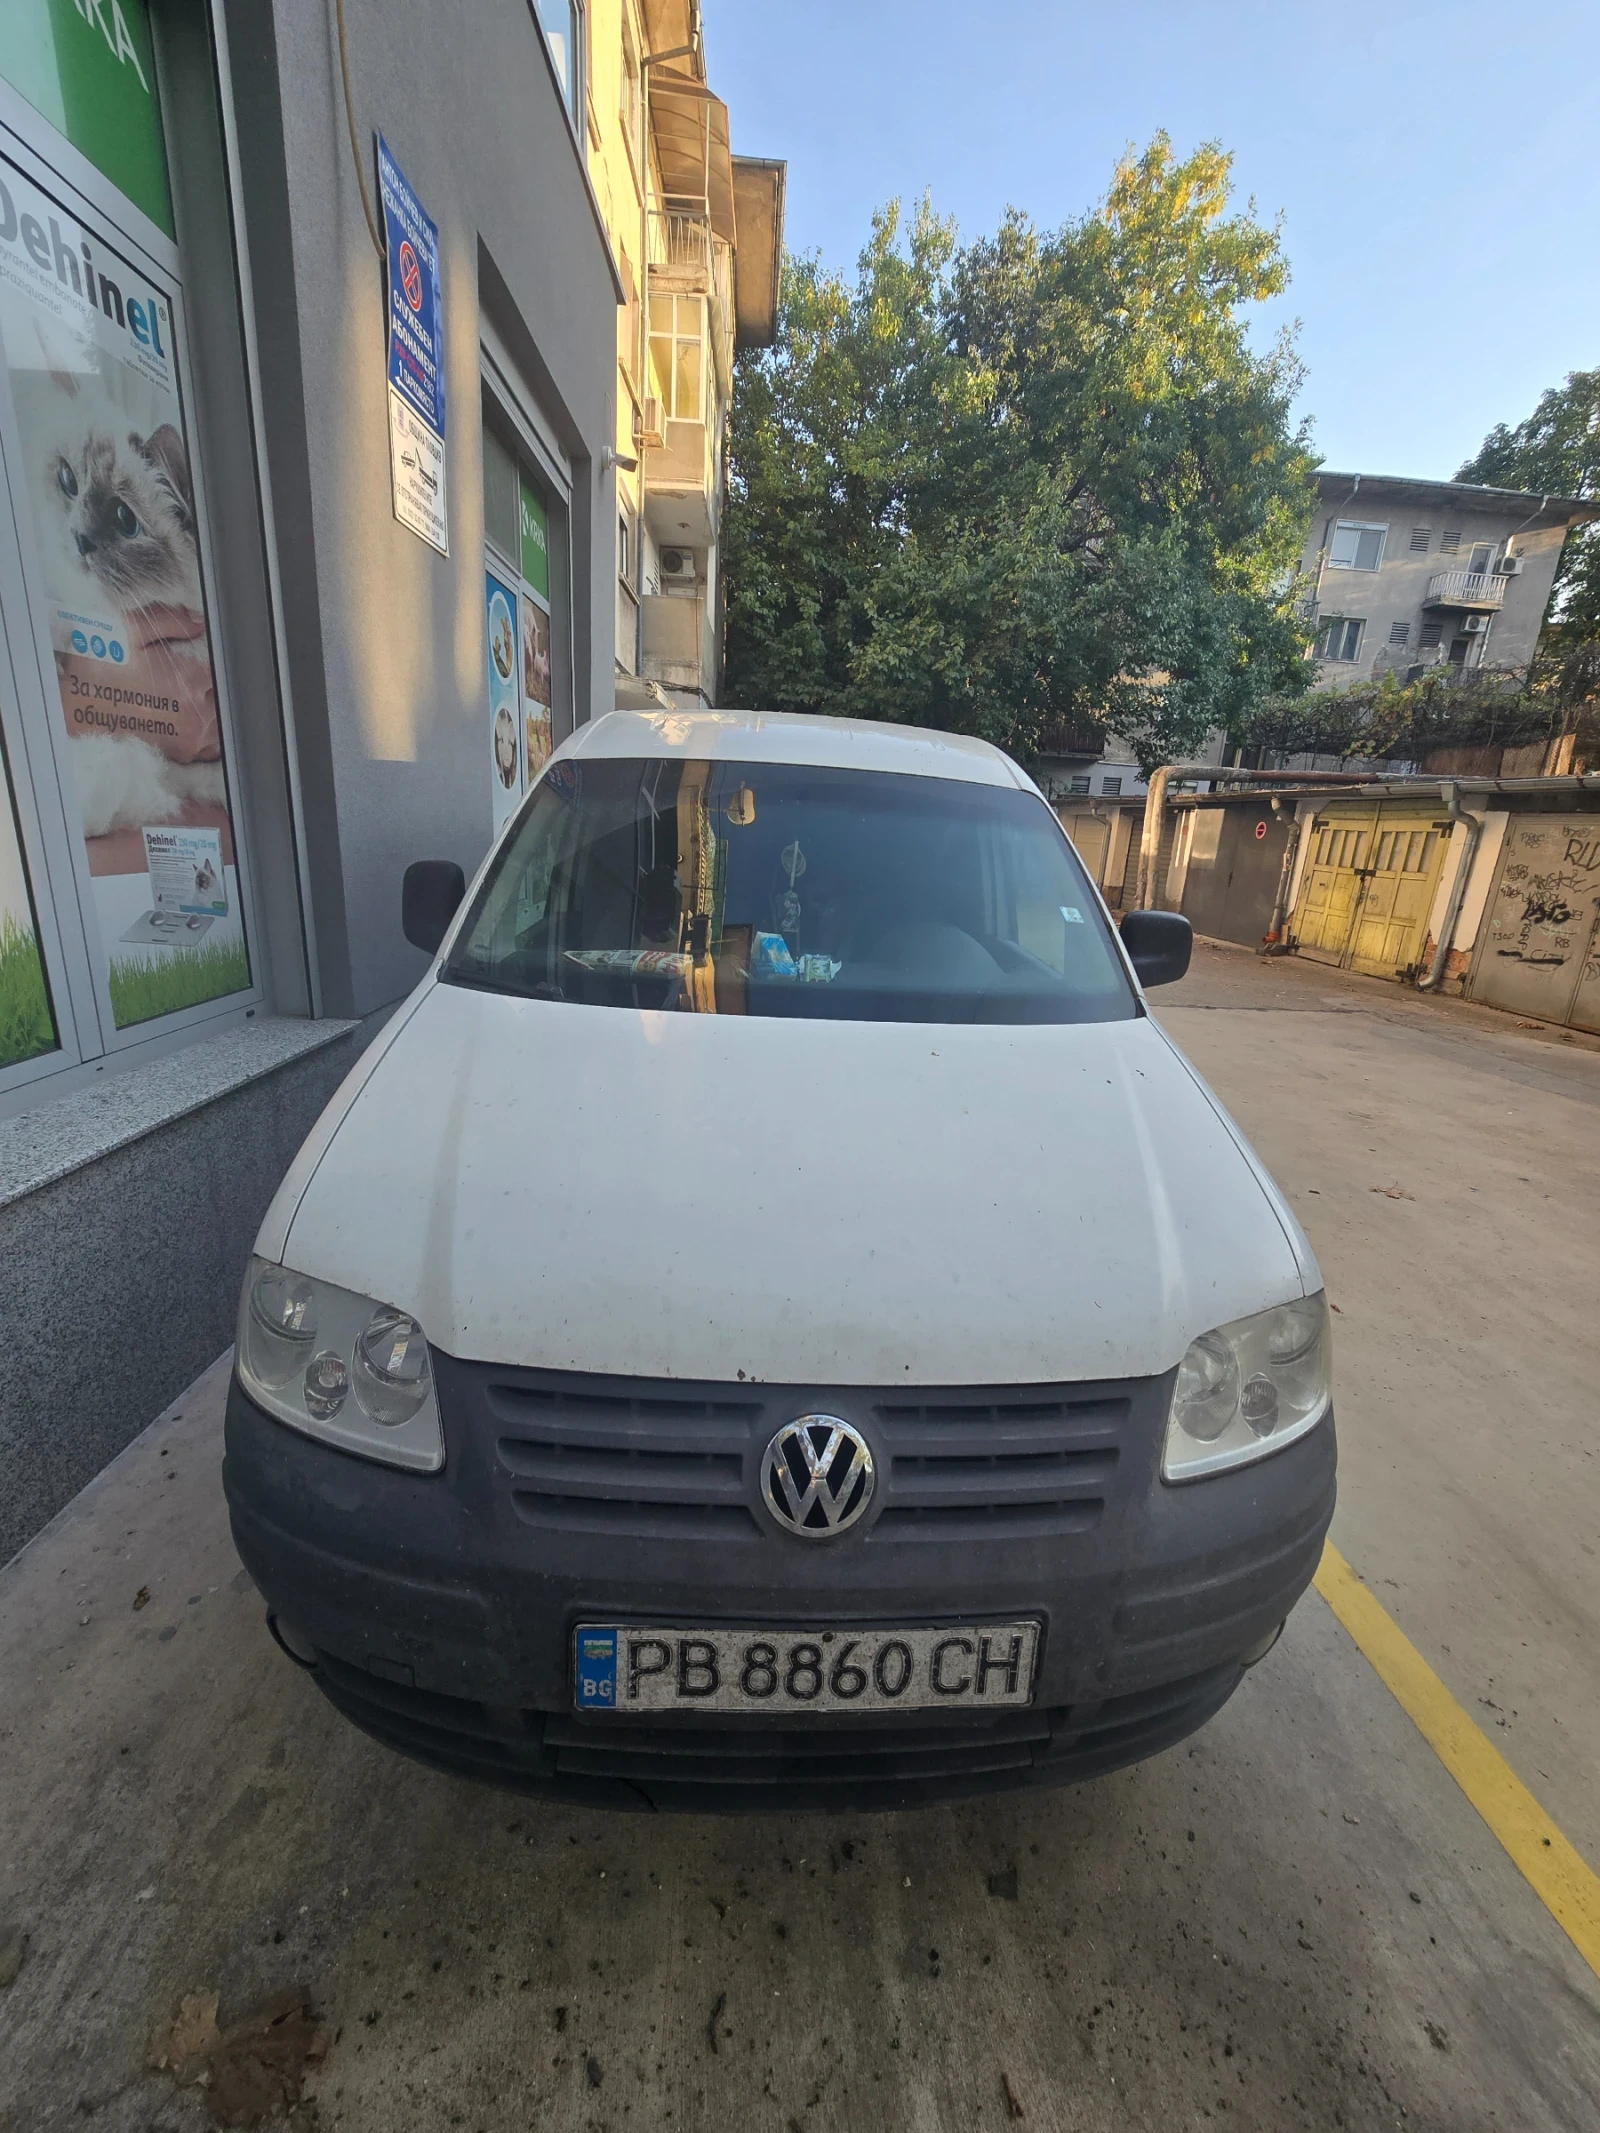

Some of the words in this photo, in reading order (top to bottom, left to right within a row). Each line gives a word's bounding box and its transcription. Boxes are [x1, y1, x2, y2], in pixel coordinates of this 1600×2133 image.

[393, 289, 433, 355] СЛУЖЕБЕН
[392, 314, 437, 382] АБОНАМЕНТ
[70, 675, 89, 697] За
[93, 684, 169, 713] хармония
[172, 699, 179, 713] в
[73, 705, 179, 737] общуването.
[146, 833, 177, 848] Dehinel
[1554, 937, 1570, 949] RB
[627, 1638, 721, 1699] PB
[740, 1638, 915, 1700] 8860
[929, 1634, 1021, 1697] CH
[582, 1678, 613, 1699] BG
